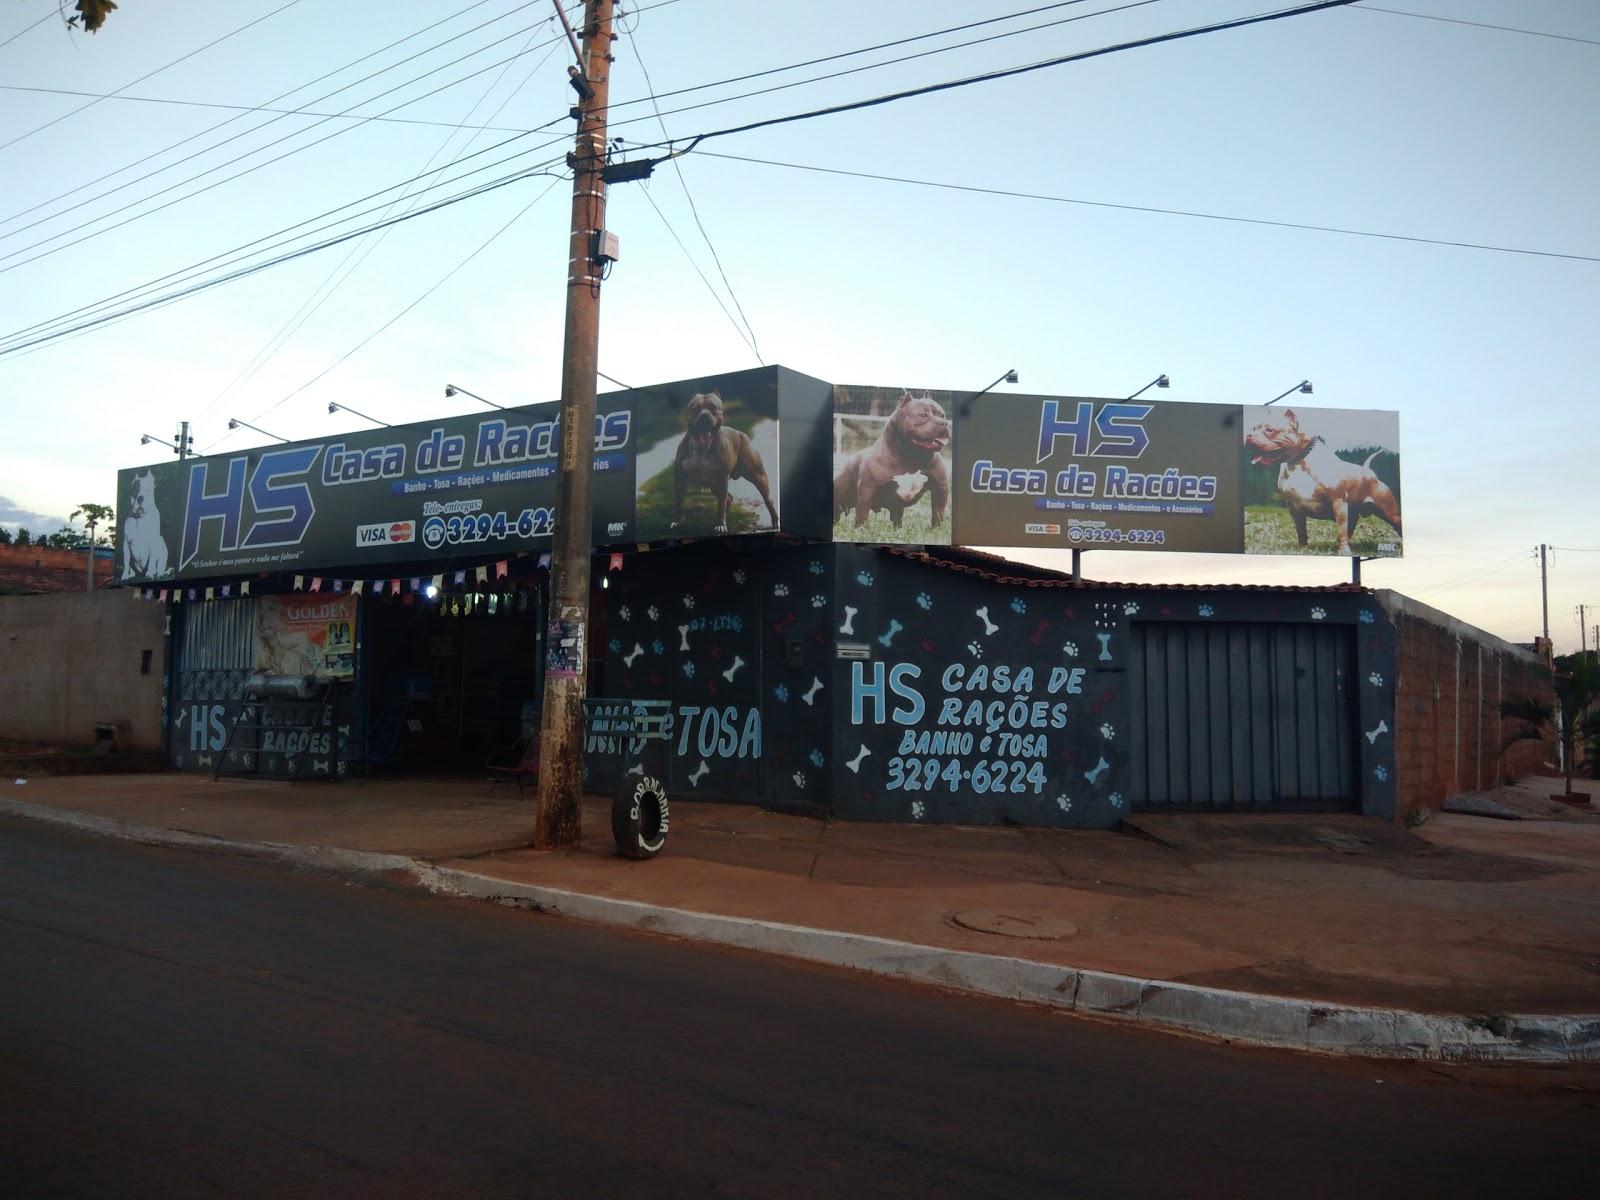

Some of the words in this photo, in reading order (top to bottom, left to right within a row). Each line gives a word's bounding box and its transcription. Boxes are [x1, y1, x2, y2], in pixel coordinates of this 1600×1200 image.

[1036, 400, 1154, 464] HS
[322, 443, 406, 487] Casa
[415, 428, 465, 474] de
[404, 482, 427, 493] Banho
[434, 478, 450, 490] Tosa
[457, 474, 485, 488] Rações
[492, 468, 549, 482] Medicamentos
[971, 460, 1047, 495] Casa
[1055, 464, 1096, 496] de
[179, 443, 325, 572] HS
[1046, 500, 1066, 510] Banho
[361, 528, 386, 542] VISA
[447, 507, 555, 544] 3294-62
[1083, 527, 1165, 544] 3294-6224
[288, 603, 350, 620] GOLDEN
[850, 661, 926, 726] HS
[942, 663, 1034, 693] CASA
[1047, 667, 1086, 694] DE
[190, 704, 226, 752] HS
[678, 706, 762, 759] TOSA
[937, 695, 1068, 734] RAÇÕES
[898, 729, 974, 756] BANHO
[979, 735, 992, 753] e
[998, 732, 1048, 758] TOSA
